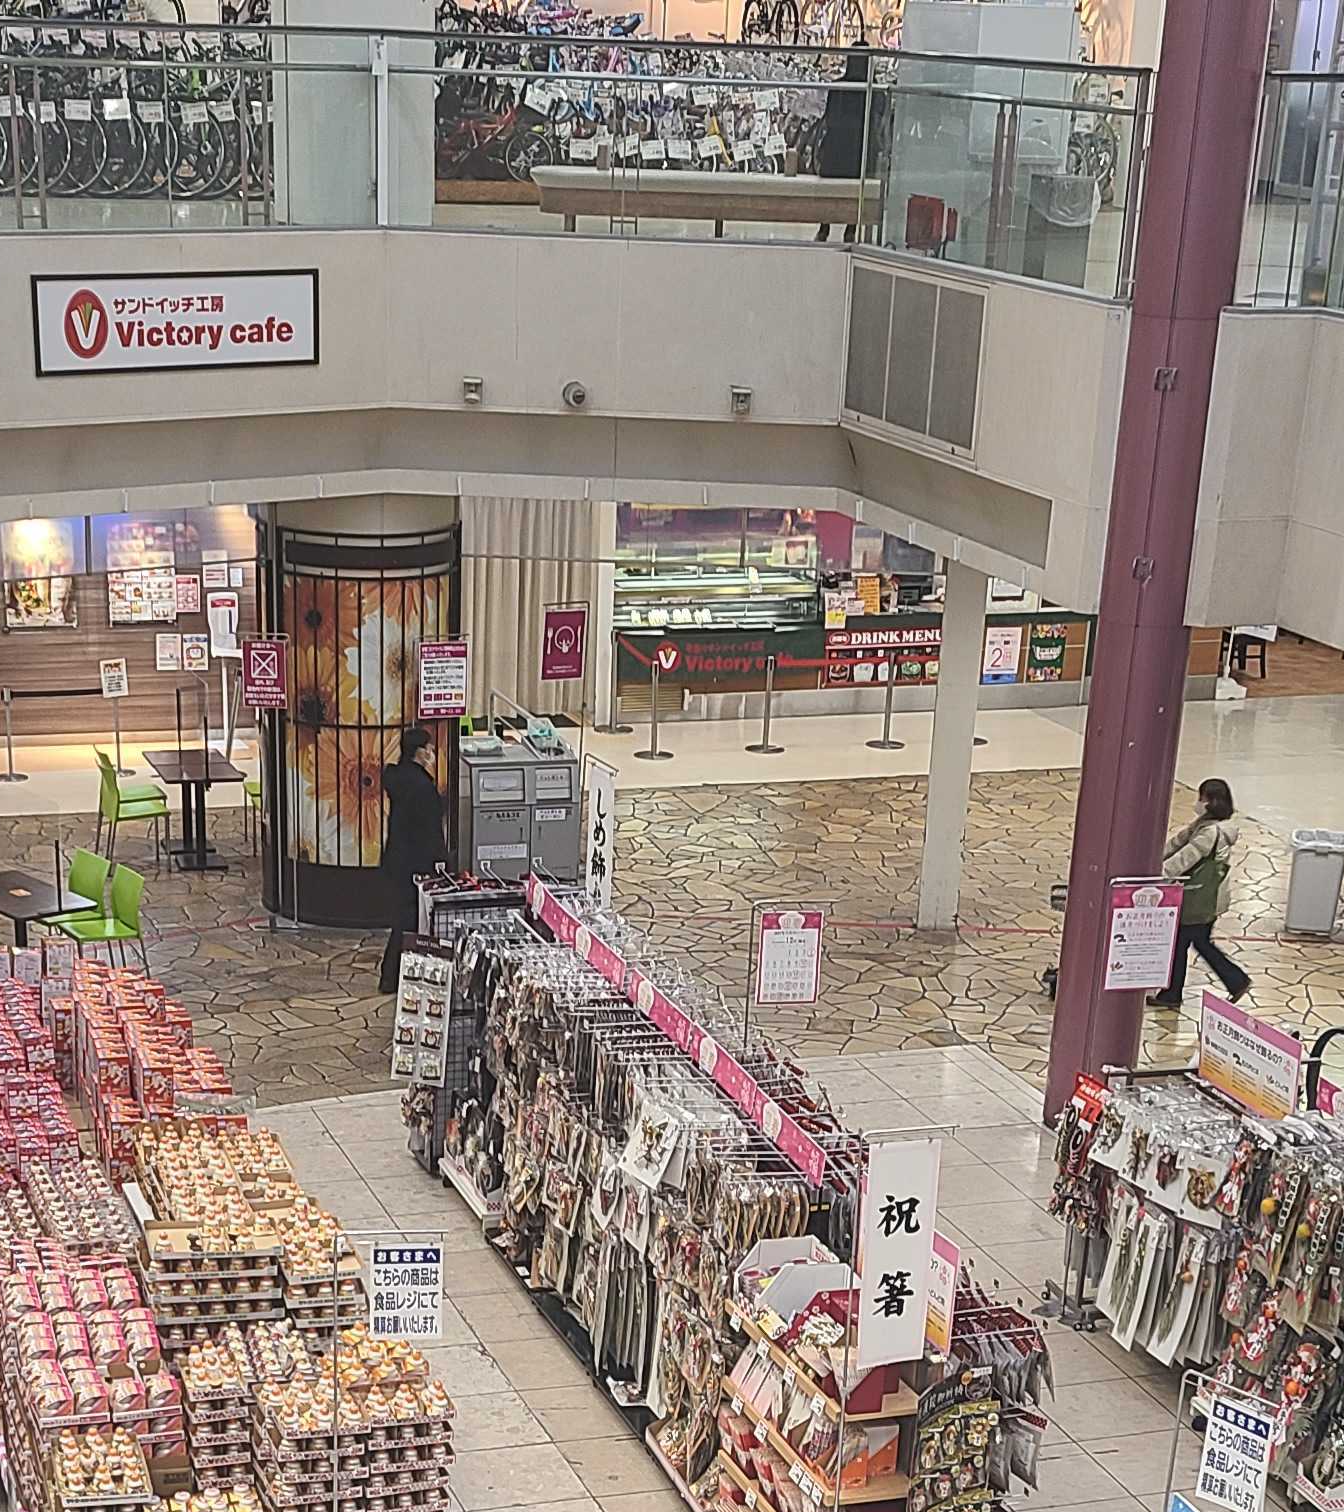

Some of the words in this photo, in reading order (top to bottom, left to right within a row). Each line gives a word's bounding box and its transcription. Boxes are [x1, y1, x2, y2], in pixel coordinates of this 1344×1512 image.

[113, 295, 224, 315] サンドイッチ工房
[115, 321, 224, 350] Victory
[229, 317, 294, 344] cafe
[850, 631, 897, 645] DRINK
[374, 1268, 439, 1286] こちらの商品は
[374, 1291, 439, 1310] 食品レジにて
[1210, 1422, 1266, 1462] こちらの商品は
[1205, 1447, 1262, 1489] 食品レジにて
